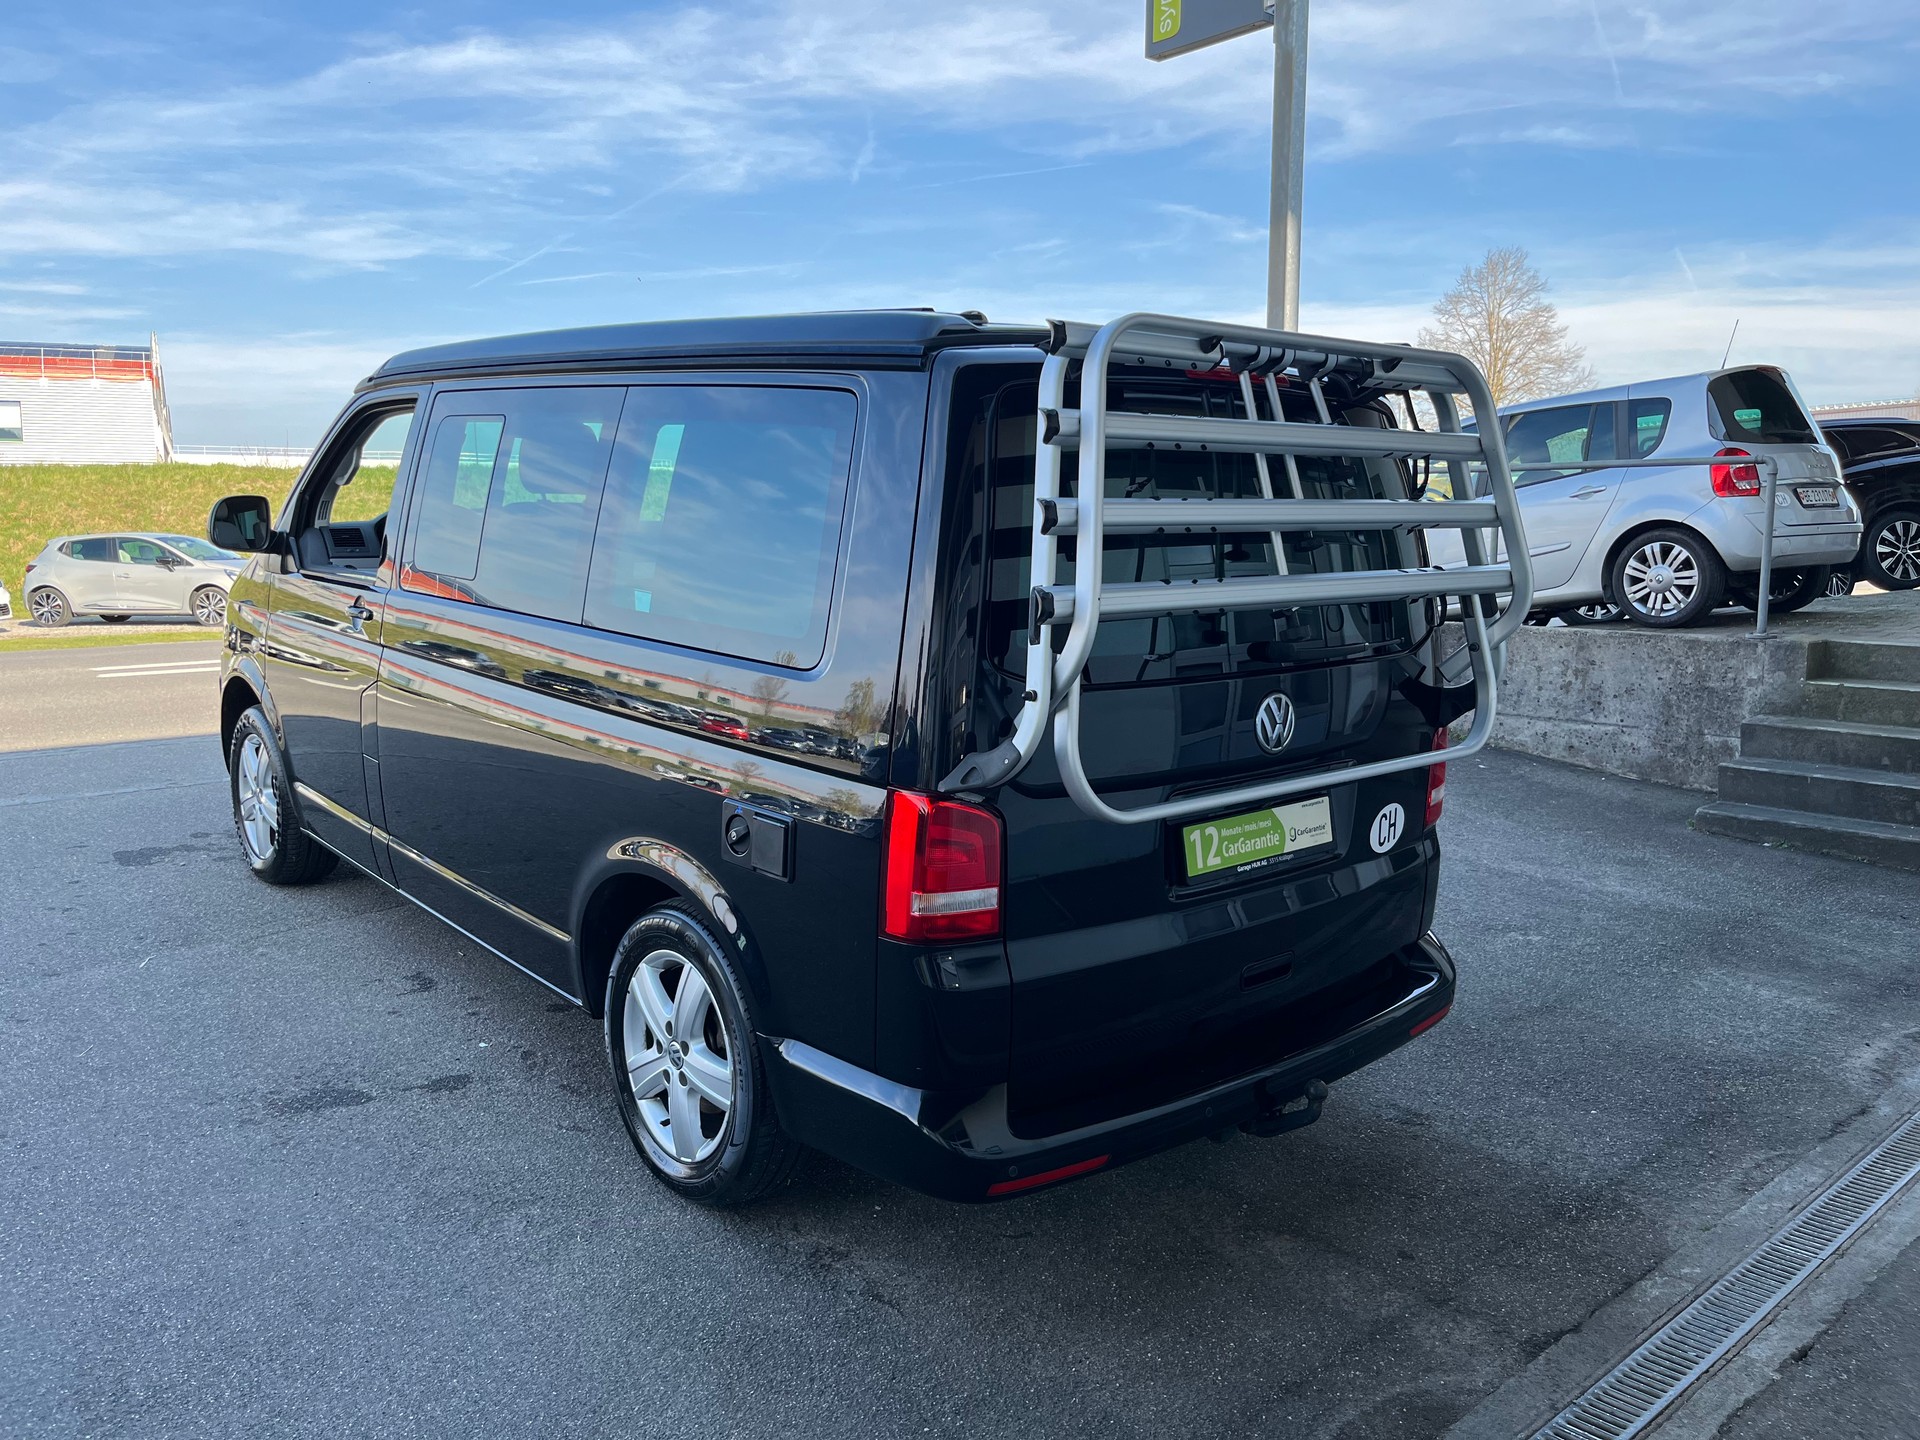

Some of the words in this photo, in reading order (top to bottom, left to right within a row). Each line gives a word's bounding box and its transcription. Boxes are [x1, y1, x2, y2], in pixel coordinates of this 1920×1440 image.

[1189, 826, 1221, 869] 12
[1222, 831, 1280, 857] CarGarantie
[1378, 807, 1398, 848] CH
